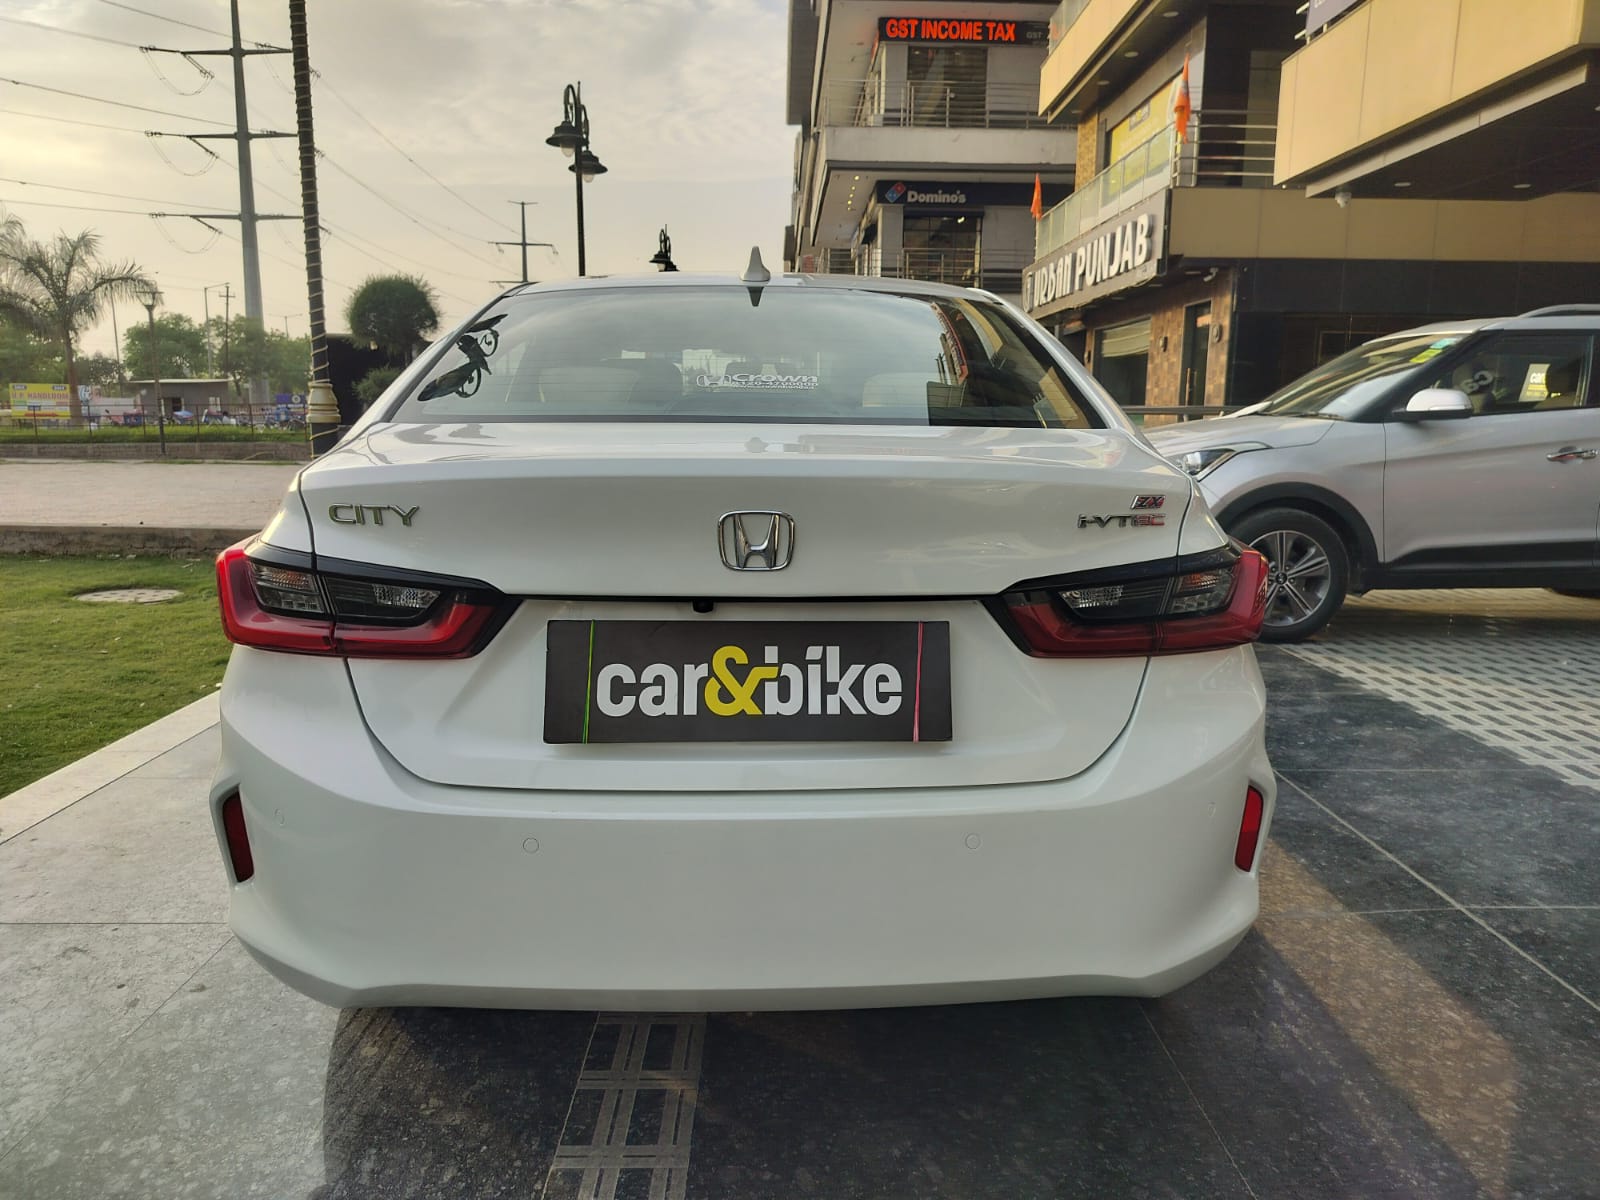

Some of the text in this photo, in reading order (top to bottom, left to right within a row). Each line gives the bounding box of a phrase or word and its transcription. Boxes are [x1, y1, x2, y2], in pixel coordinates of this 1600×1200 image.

[886, 18, 1016, 42] GST INCOME TAX
[907, 189, 967, 204] Domino's
[1074, 213, 1150, 291] PUNJAB
[1132, 495, 1165, 510] ZX
[328, 503, 419, 527] CITY
[596, 645, 903, 717] car&bike
